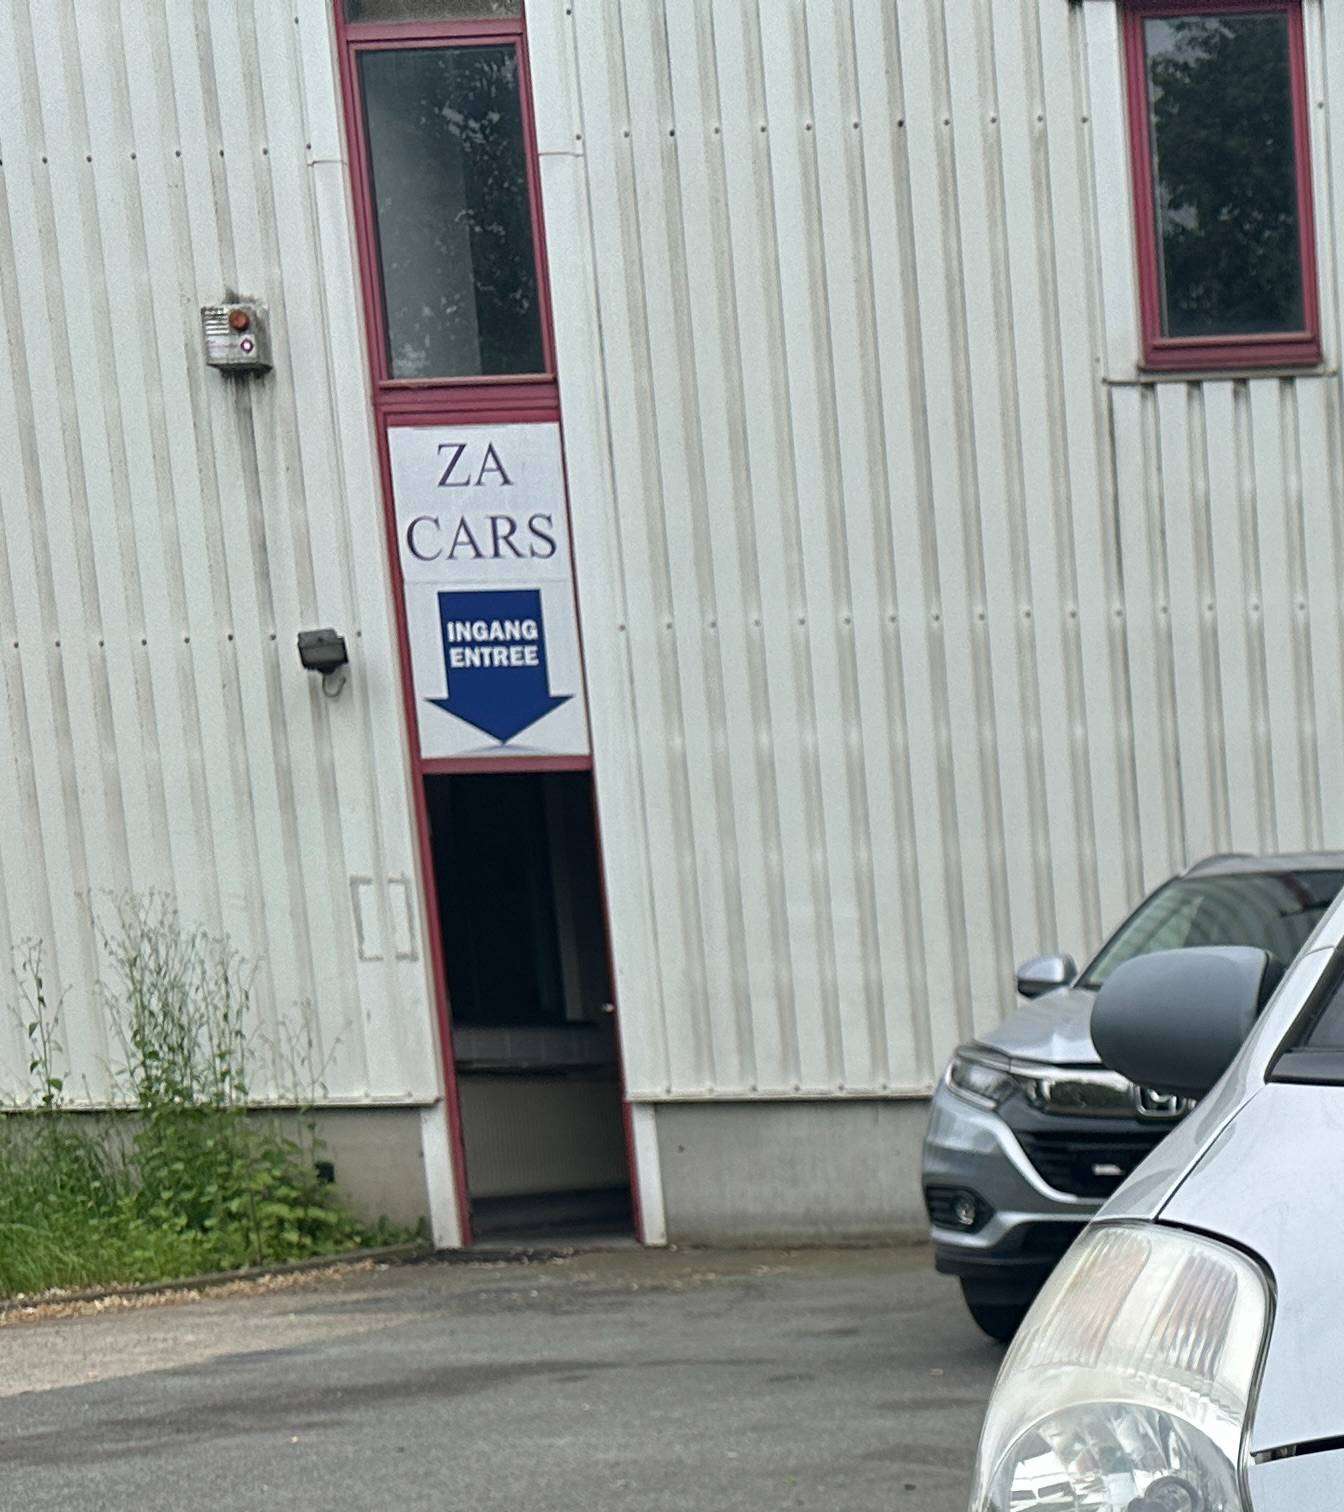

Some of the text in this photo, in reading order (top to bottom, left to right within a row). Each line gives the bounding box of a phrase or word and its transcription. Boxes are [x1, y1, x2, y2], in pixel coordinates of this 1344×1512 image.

[437, 442, 514, 488] ZA
[406, 513, 558, 562] CARS
[447, 619, 539, 642] INGANG
[450, 645, 540, 669] ENTREE
